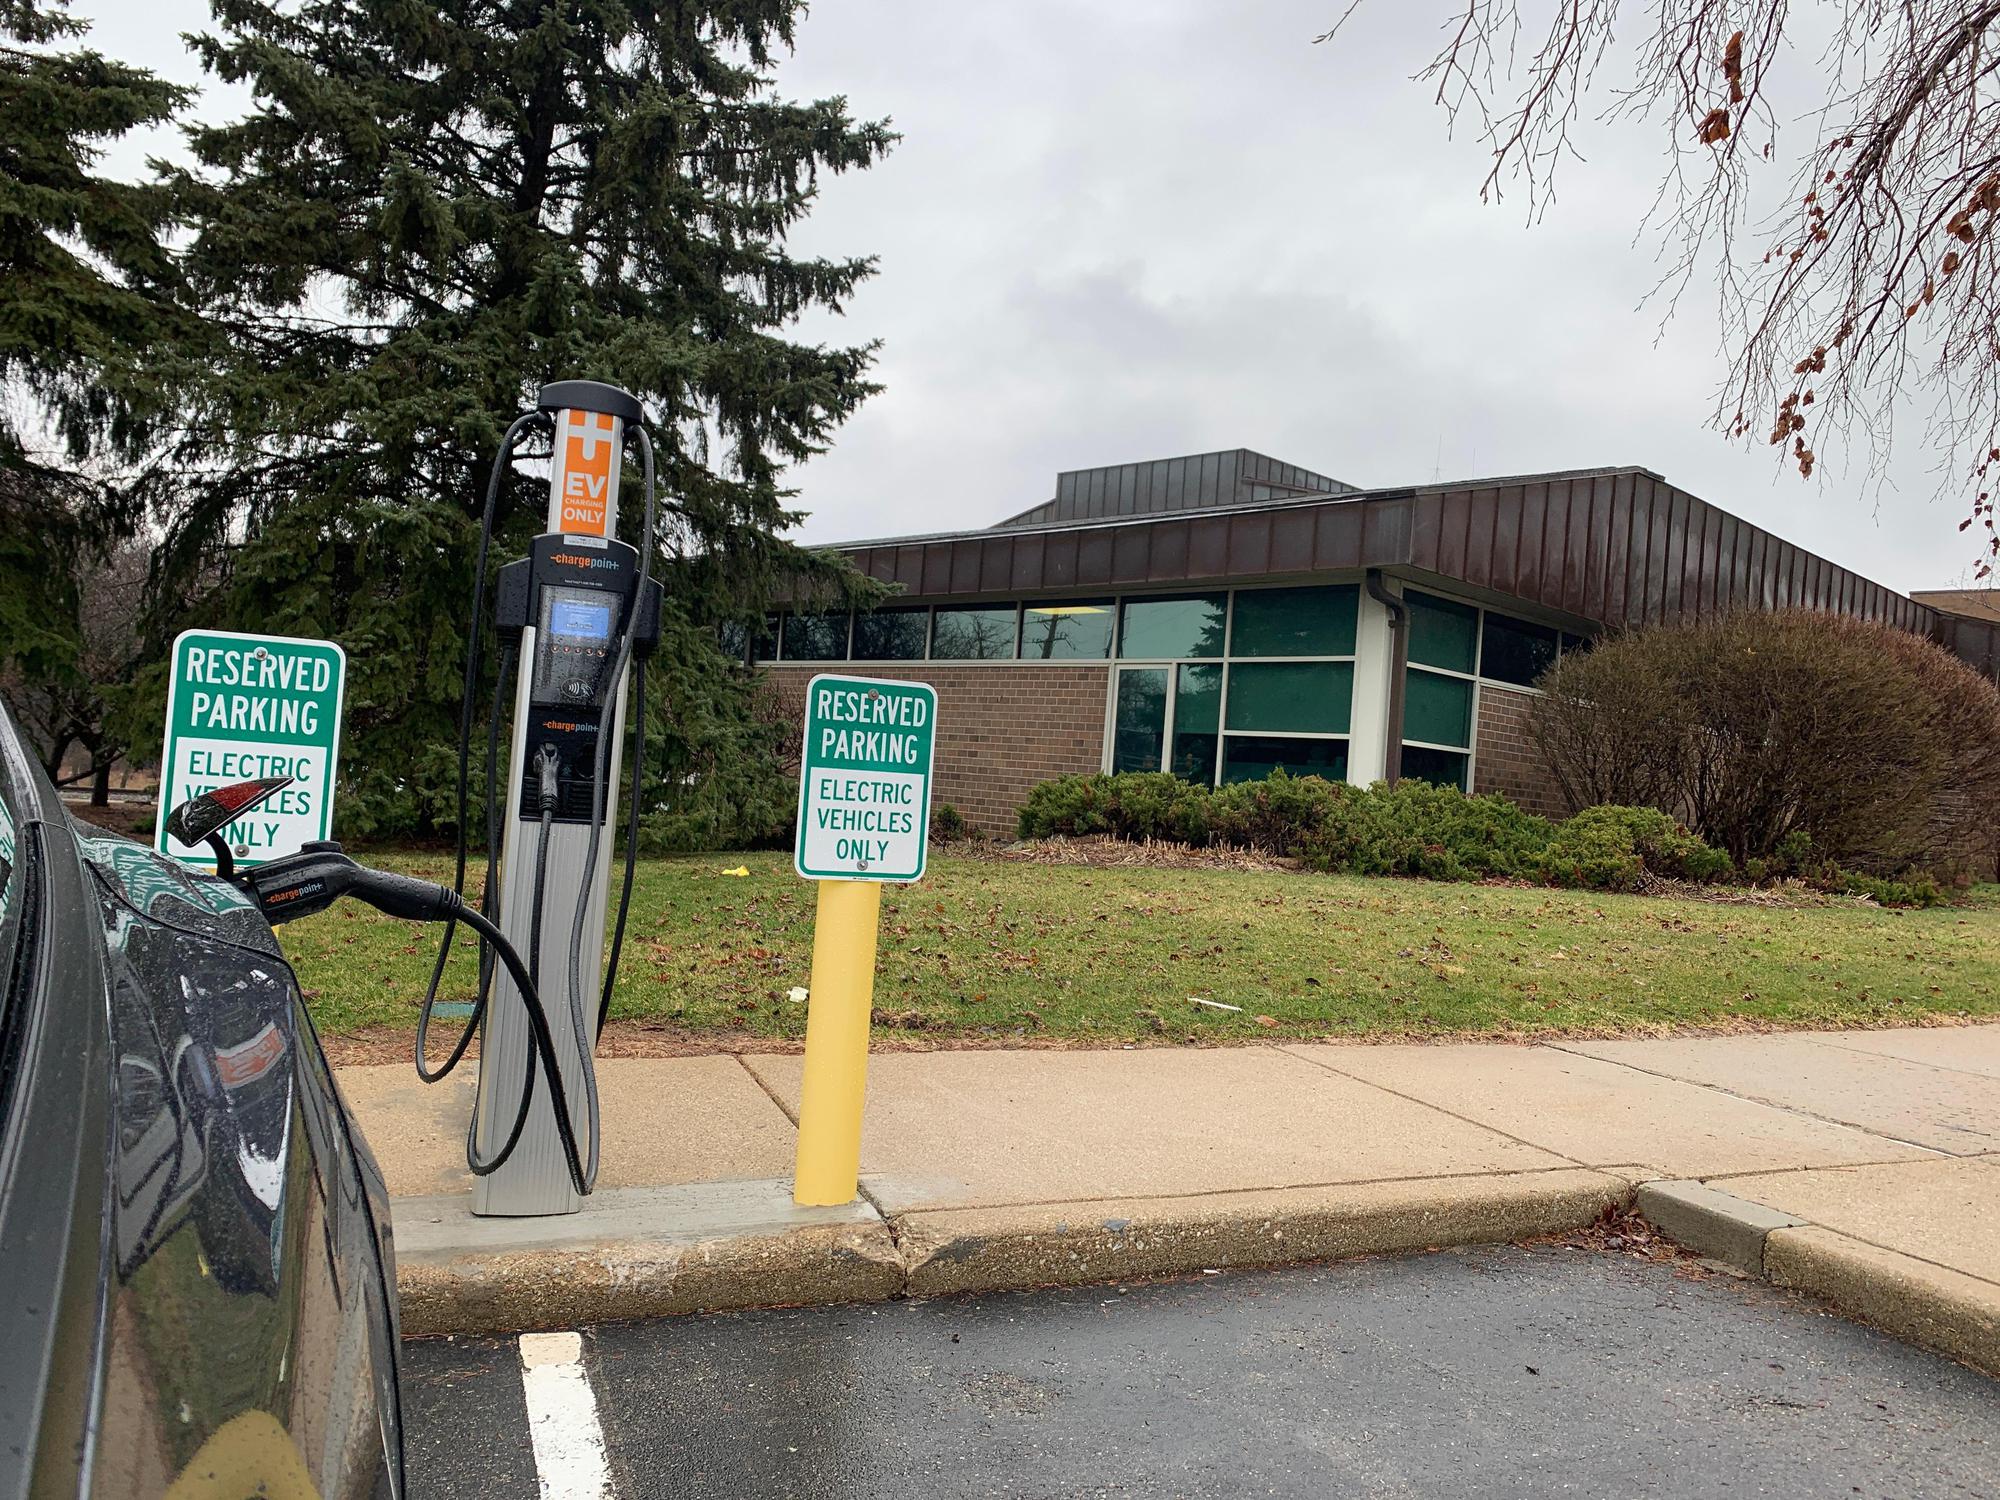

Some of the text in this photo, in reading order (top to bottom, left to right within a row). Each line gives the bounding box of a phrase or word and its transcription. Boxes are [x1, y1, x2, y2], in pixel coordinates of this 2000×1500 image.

[565, 471, 606, 498] EV
[563, 507, 604, 524] ONLY
[565, 497, 604, 509] CHARGING
[186, 647, 331, 692] RESERVED
[190, 692, 318, 736] PARKING
[817, 689, 927, 727] RESERVED
[821, 728, 918, 764] PARKING
[189, 750, 312, 782] ELECTRIC
[820, 778, 912, 805] ELECTRIC
[817, 808, 912, 833] VEHICLES
[221, 822, 280, 847] NLY
[836, 838, 889, 861] ONLY
